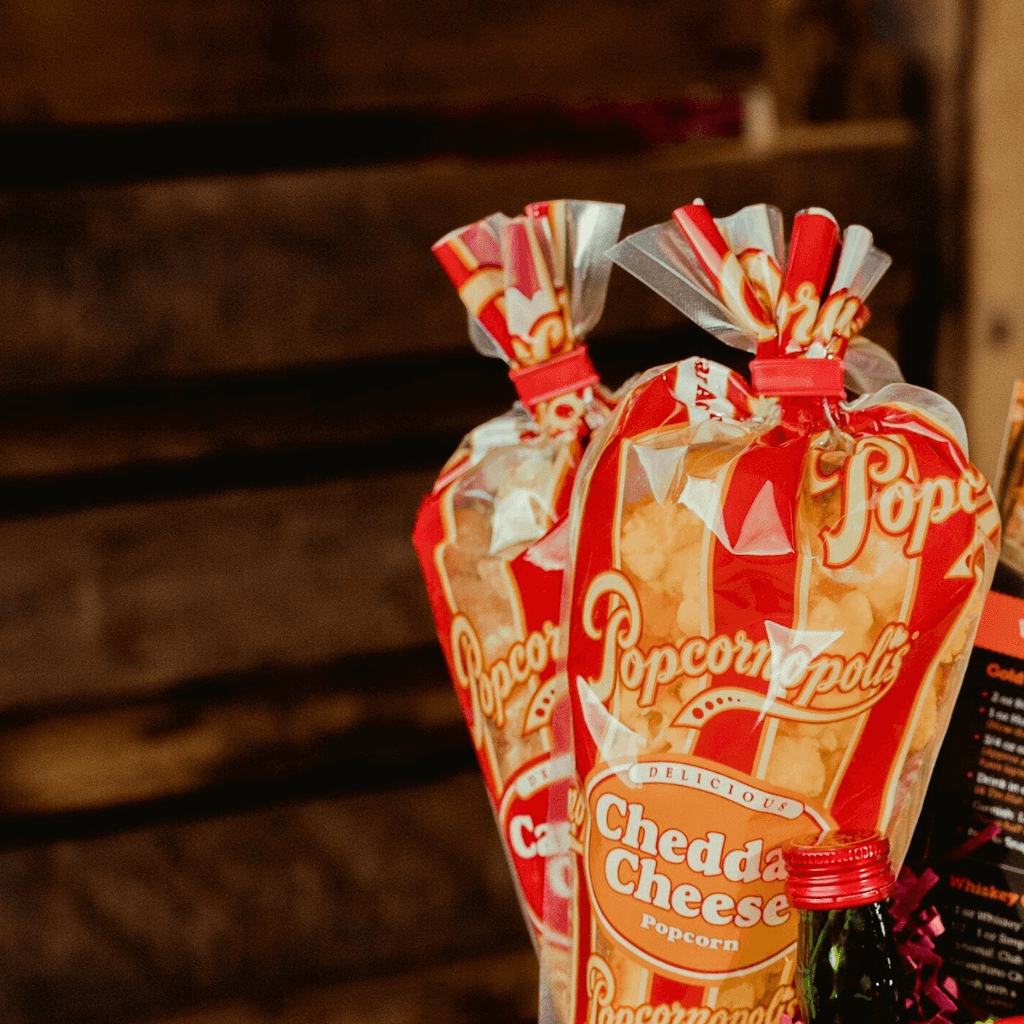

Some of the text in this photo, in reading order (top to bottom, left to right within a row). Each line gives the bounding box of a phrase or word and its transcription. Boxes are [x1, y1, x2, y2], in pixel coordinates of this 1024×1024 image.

[649, 767, 788, 812] DELICIOUS
[595, 793, 789, 884] Chedda
[604, 848, 791, 928] Cheese
[640, 912, 740, 951] Popcorn
